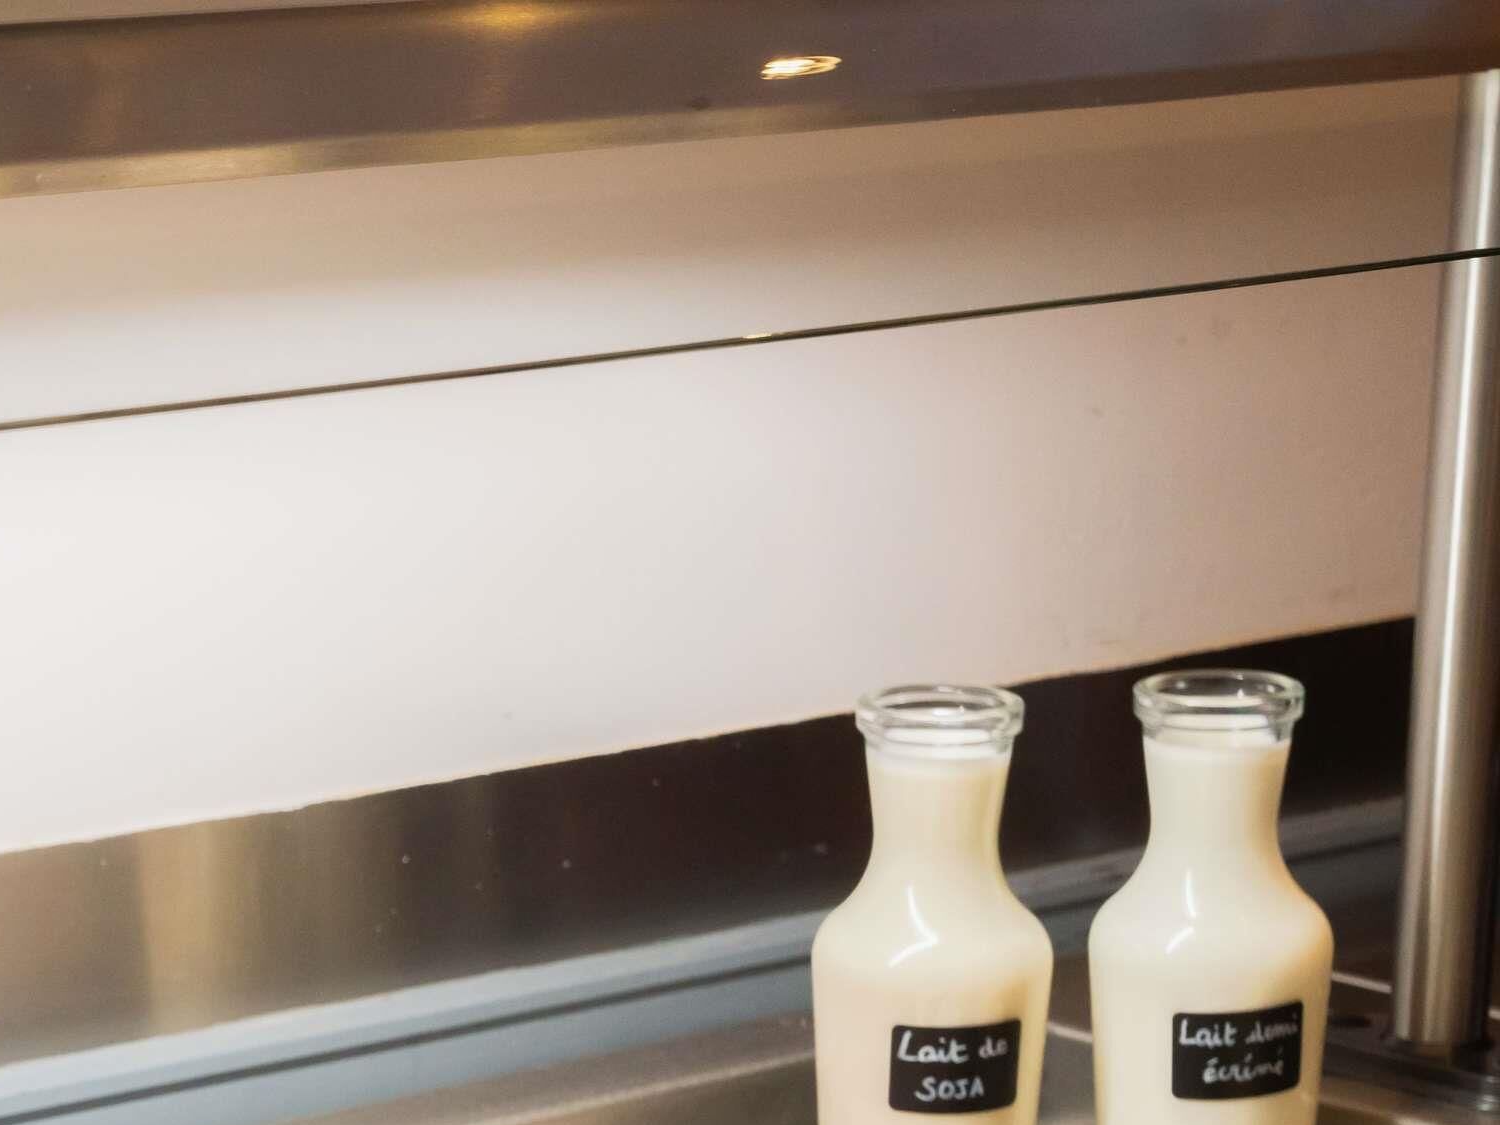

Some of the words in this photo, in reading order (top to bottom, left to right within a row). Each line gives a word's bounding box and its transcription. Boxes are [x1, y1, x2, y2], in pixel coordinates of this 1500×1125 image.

[897, 1030, 969, 1064] Lait
[978, 1036, 1008, 1059] de
[1179, 1018, 1238, 1049] Lait
[914, 1076, 984, 1102] SOJA
